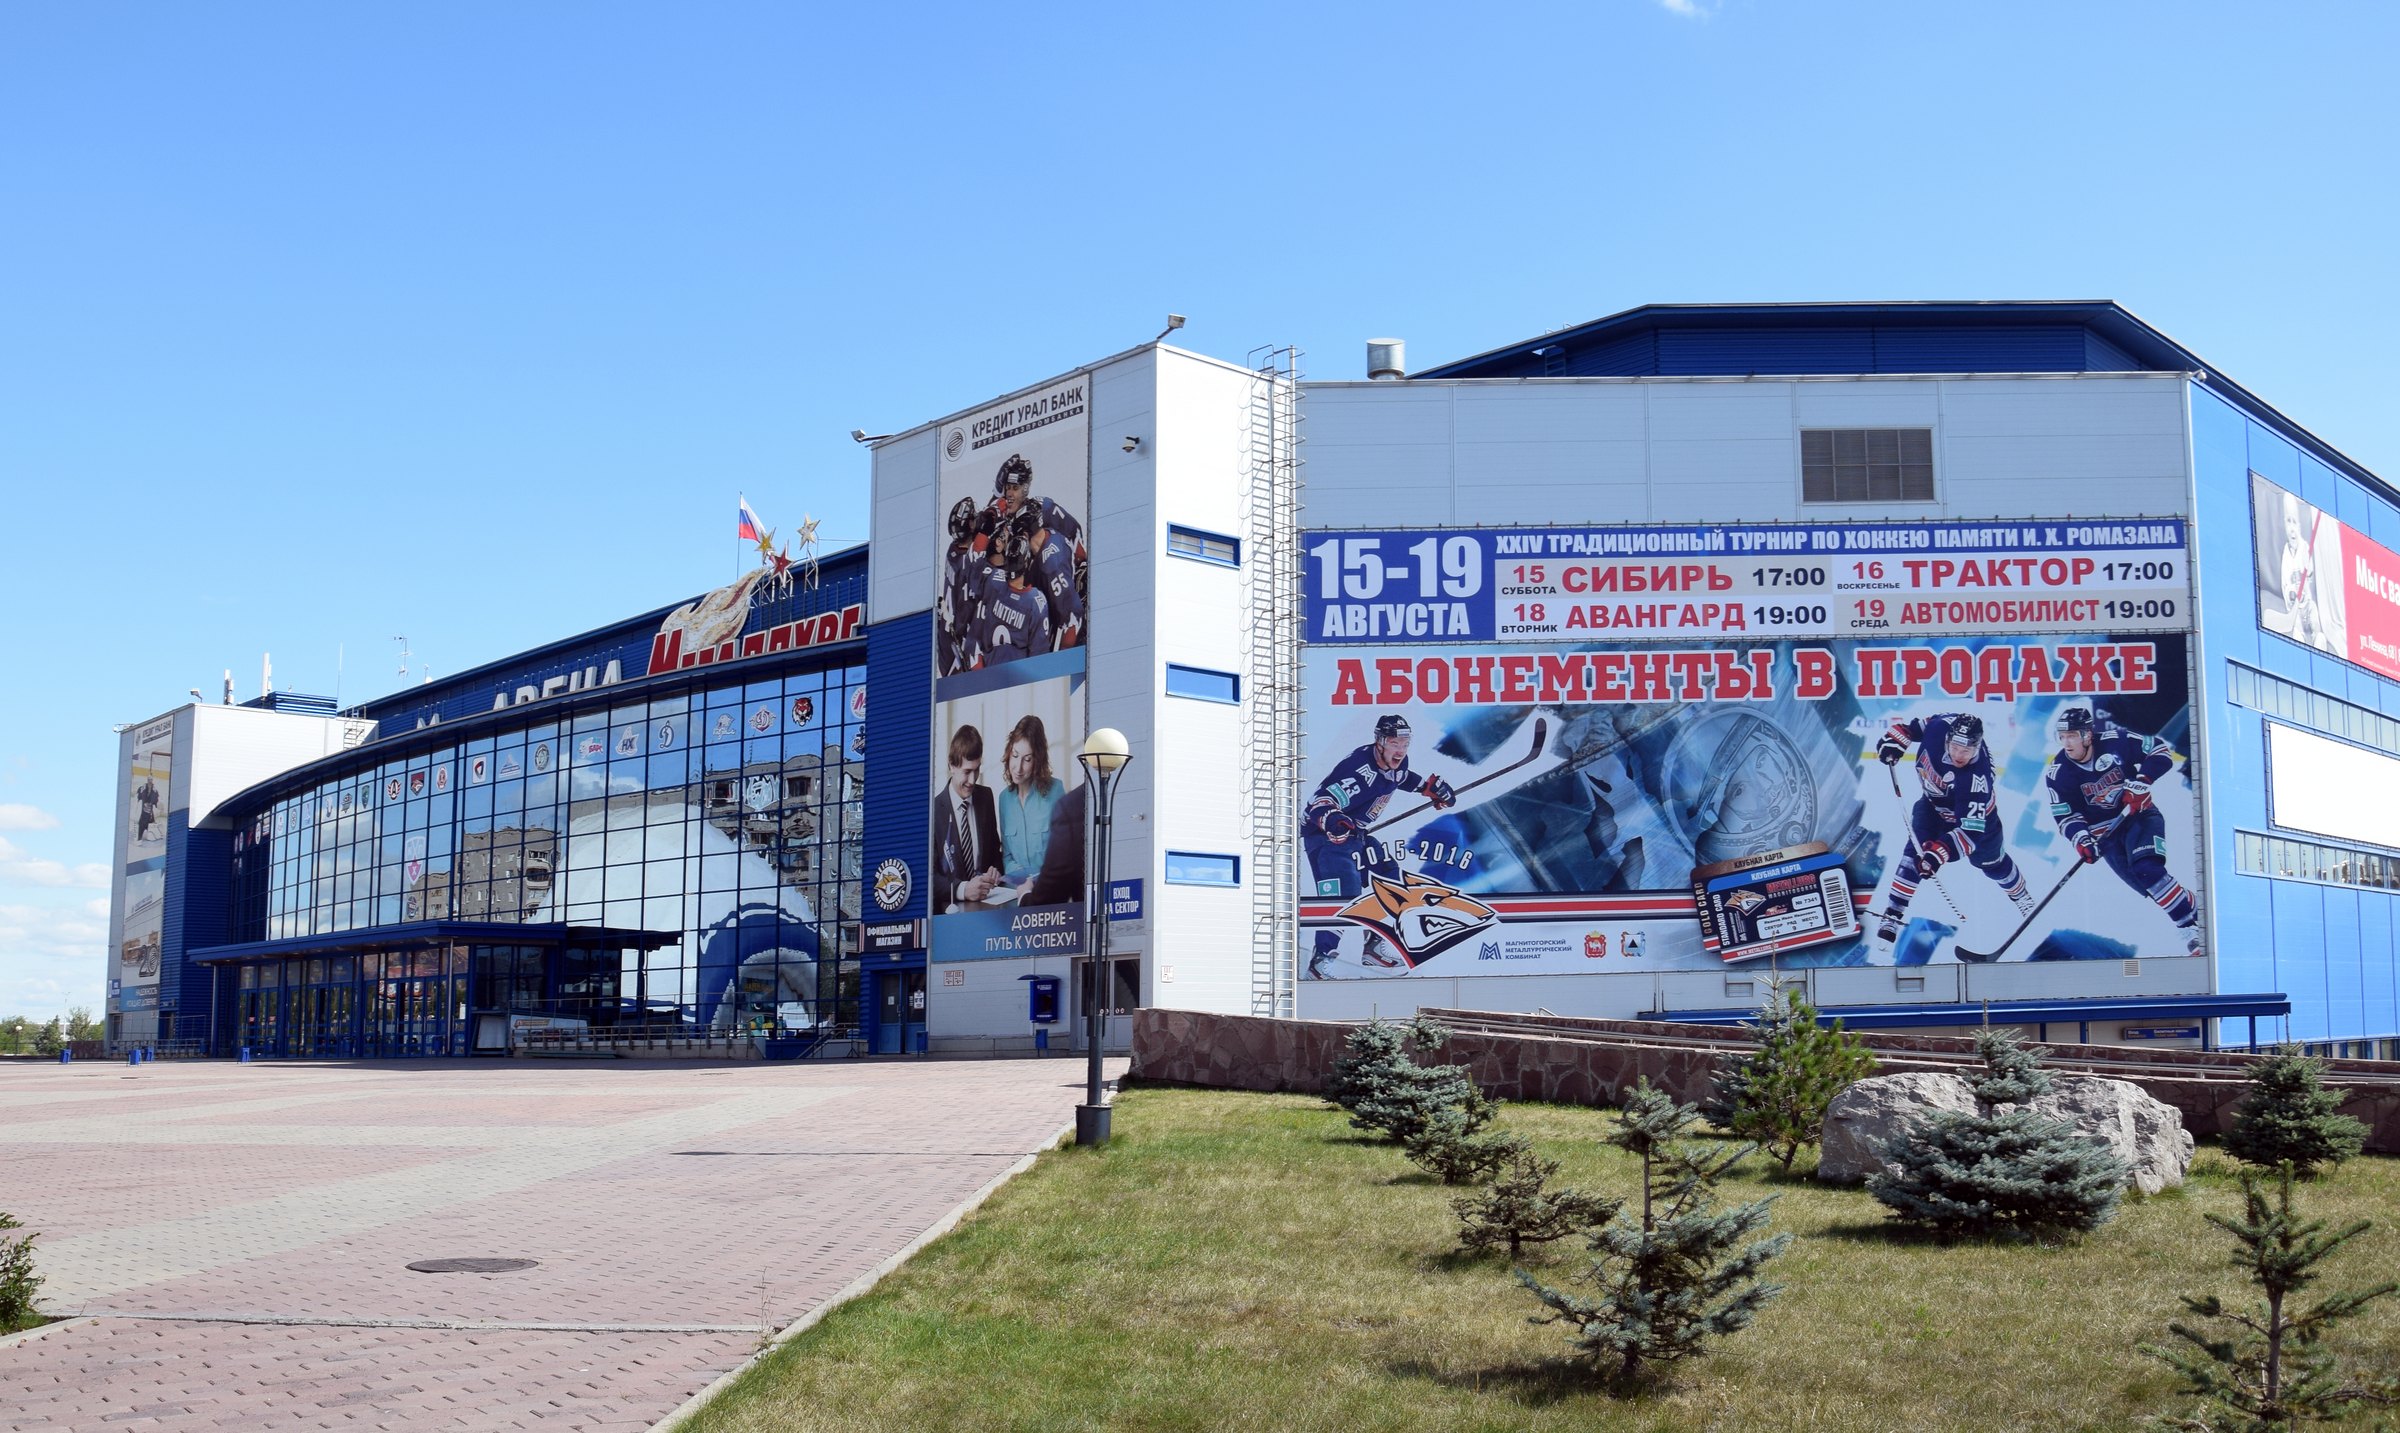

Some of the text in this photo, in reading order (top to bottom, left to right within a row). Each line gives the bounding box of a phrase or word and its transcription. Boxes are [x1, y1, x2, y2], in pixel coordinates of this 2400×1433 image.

[972, 386, 1083, 439] КРЕДИТ УРАЛ БАНК
[972, 407, 1081, 449] ГРУППА ГАЗПРОМБАНКА
[1496, 525, 2177, 555] XXIV ТРАДИЦИОННЫЙ ТУРНИР ПО ХОККЕЮ ПАМЯТИ И. Х. РОМАЗАНА
[1311, 536, 1482, 599] 15-19
[1513, 565, 1545, 584] 15
[1852, 561, 1884, 580] 16
[1903, 558, 2174, 588] ТРАКТОР 17:00
[2356, 554, 2379, 596] Мы
[2380, 575, 2388, 600] с
[1051, 573, 1069, 597] 55
[1561, 565, 1825, 593] СИБИРЬ 17:00
[1837, 581, 1900, 591] ВОСКРЕСЕНЬЕ
[1501, 586, 1557, 595] СУББОТА
[993, 600, 1026, 629] ANTIPIN
[1513, 603, 1545, 622] 18
[1565, 603, 1826, 632] АВАНГАРД 19:00
[1853, 598, 1885, 618] 19
[1900, 599, 2175, 624] АВТОМОБИЛИСТ 19:00
[1322, 603, 1470, 637] АВГУСТА
[1501, 624, 1558, 634] ВТОРНИК
[1850, 619, 1889, 628] СРЕДА
[1331, 645, 2155, 706] АБОНЕМЕНТЫ В ПРОДАЖЕ
[1341, 777, 1361, 798] 43
[1967, 801, 1986, 820] 25
[1351, 840, 1473, 871] 2015-2016
[1734, 852, 1784, 868] КЛУБНАЯ КАРТА
[1751, 863, 1801, 880] КЛУБНАЯ КАРТА
[1113, 886, 1130, 899] ВХОД
[1114, 900, 1139, 914] СЕКТОР
[1694, 882, 1713, 934] GOLD CARD
[866, 922, 912, 936] ОФИЦИАЛЬНЫЙ
[1011, 911, 1066, 931] ДОВЕРИЕ
[1712, 894, 1731, 946] STANDARD CARD
[876, 936, 902, 946] МАГАЗИН
[985, 931, 1076, 951] ПУТЬ К УСПЕХУ!
[1505, 938, 1566, 946] МАГНИТОГОРСКИЙ
